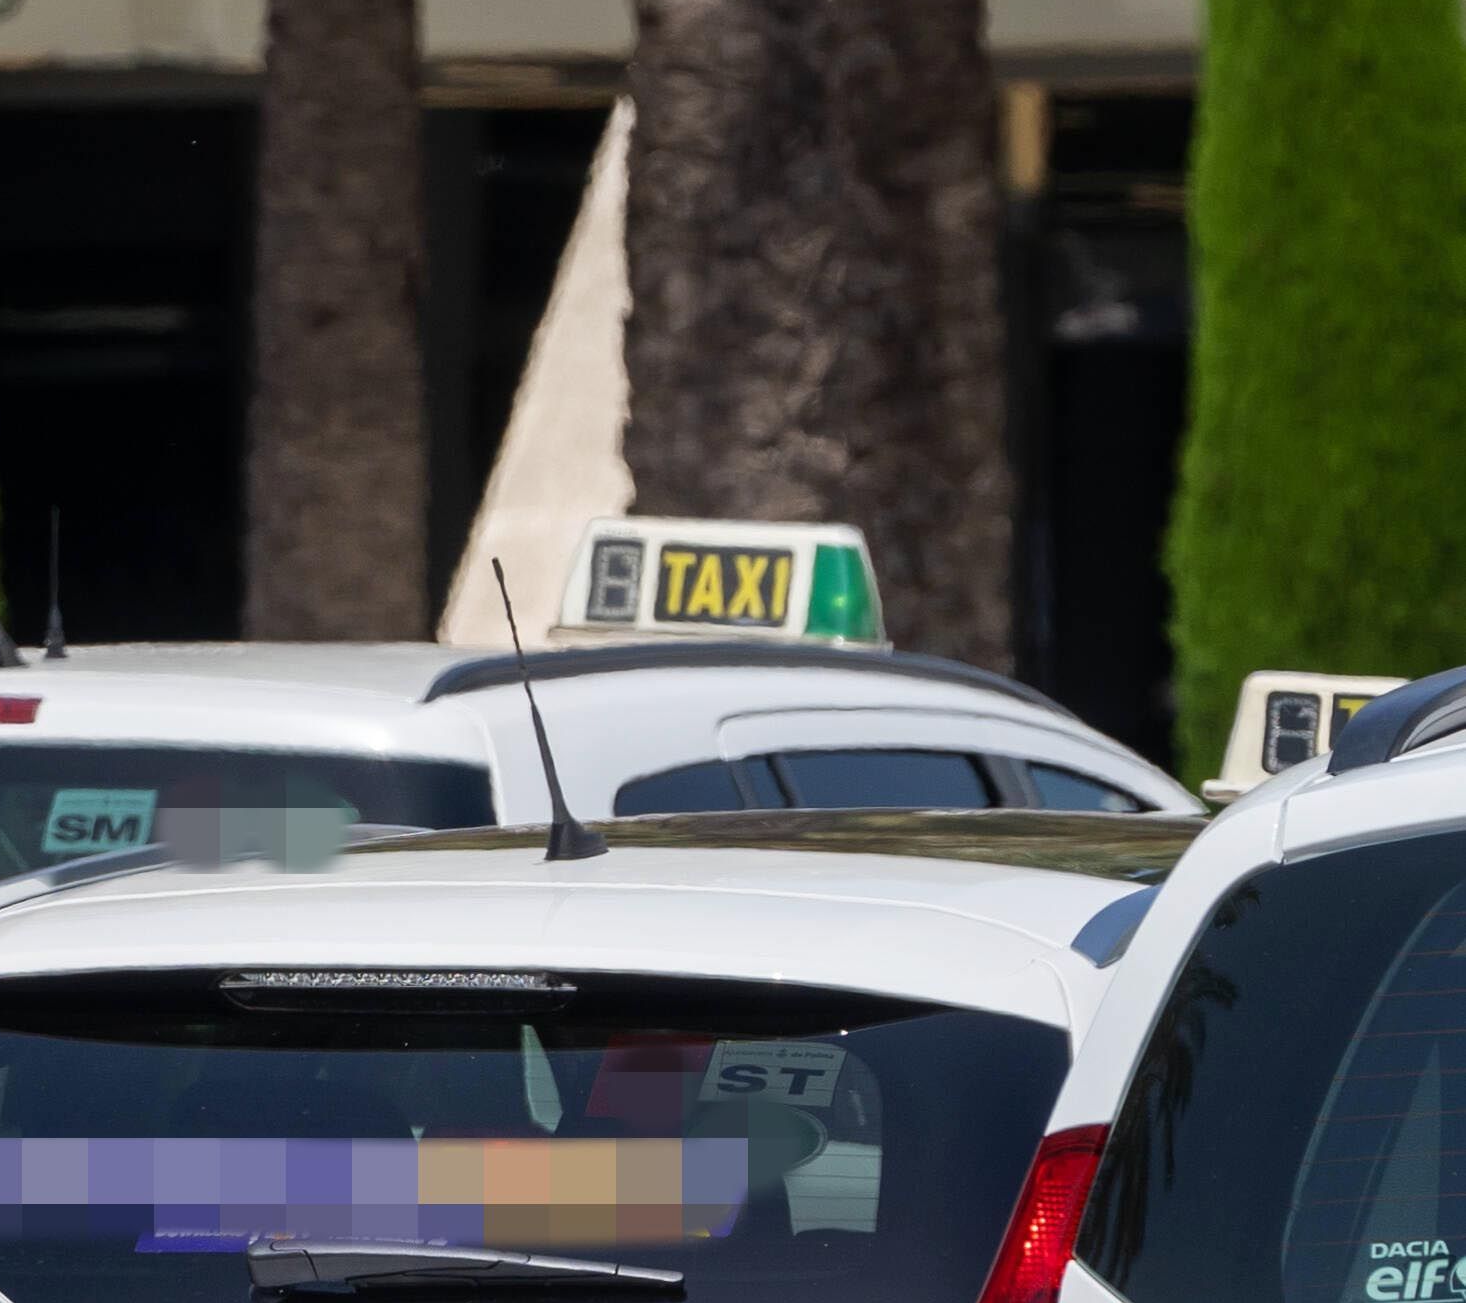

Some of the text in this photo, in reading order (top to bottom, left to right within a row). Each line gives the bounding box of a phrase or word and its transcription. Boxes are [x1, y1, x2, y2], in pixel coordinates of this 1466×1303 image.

[664, 551, 790, 619] TAXI
[53, 814, 141, 843] SM
[1371, 1240, 1449, 1258] DACIA
[1366, 1259, 1449, 1301] elf
